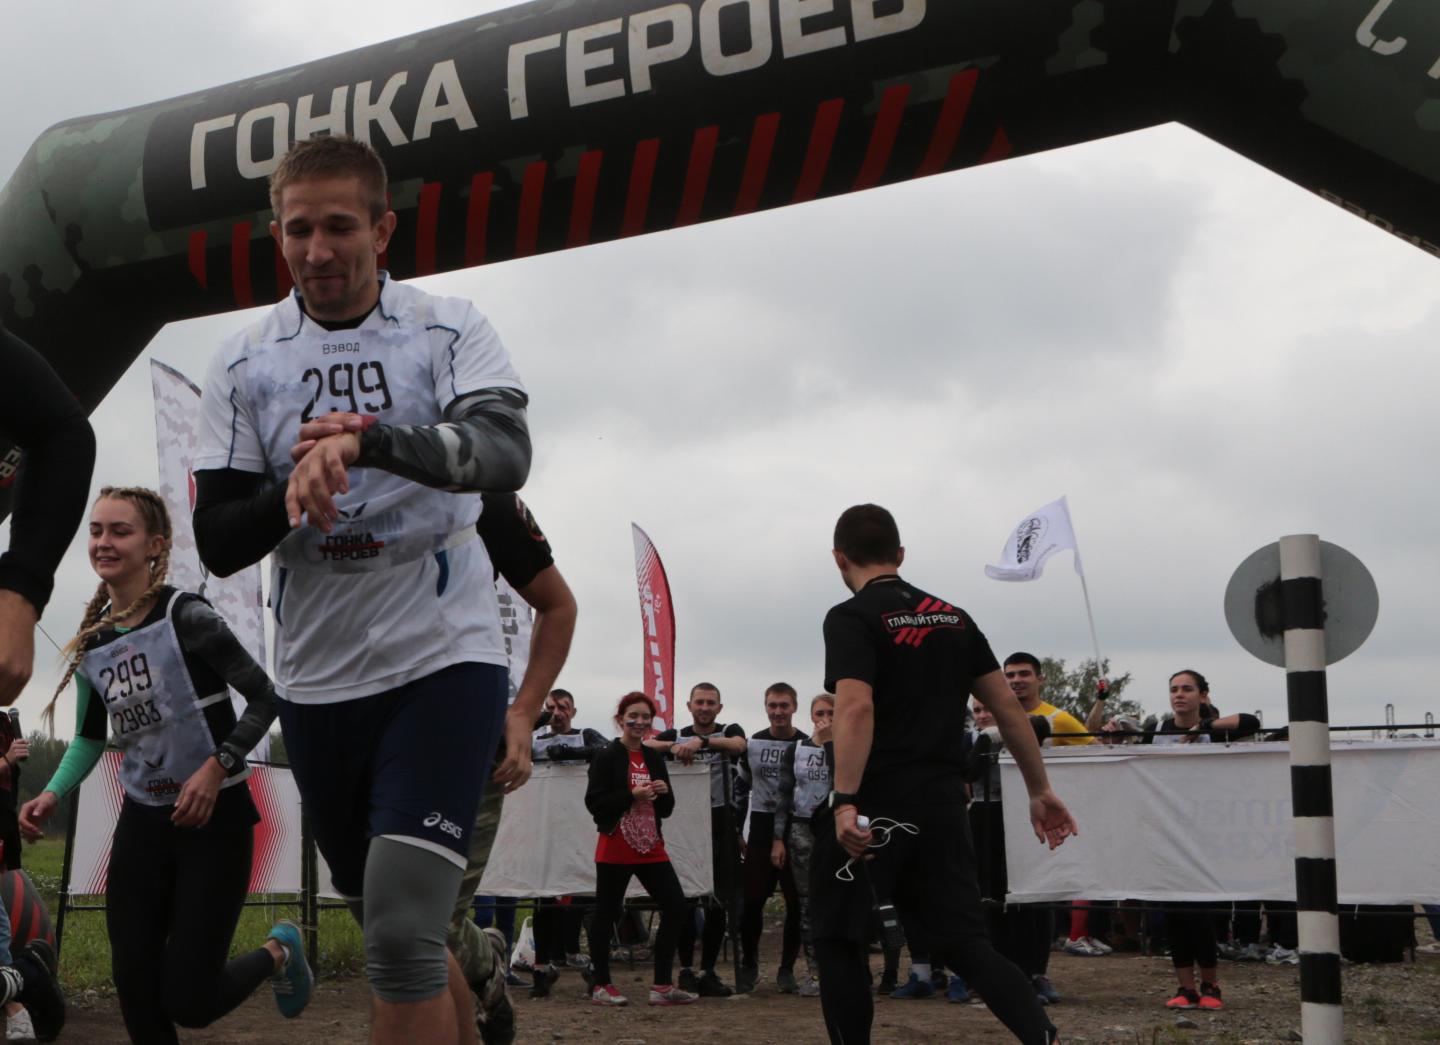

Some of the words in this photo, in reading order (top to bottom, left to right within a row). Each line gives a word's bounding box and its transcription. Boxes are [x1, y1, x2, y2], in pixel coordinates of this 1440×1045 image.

[190, 59, 478, 190] ГОНКА
[322, 342, 360, 355] Взвод
[300, 360, 393, 424] 299
[325, 530, 376, 547] ГОНКА
[99, 652, 153, 704] 299
[113, 700, 162, 734] 2983
